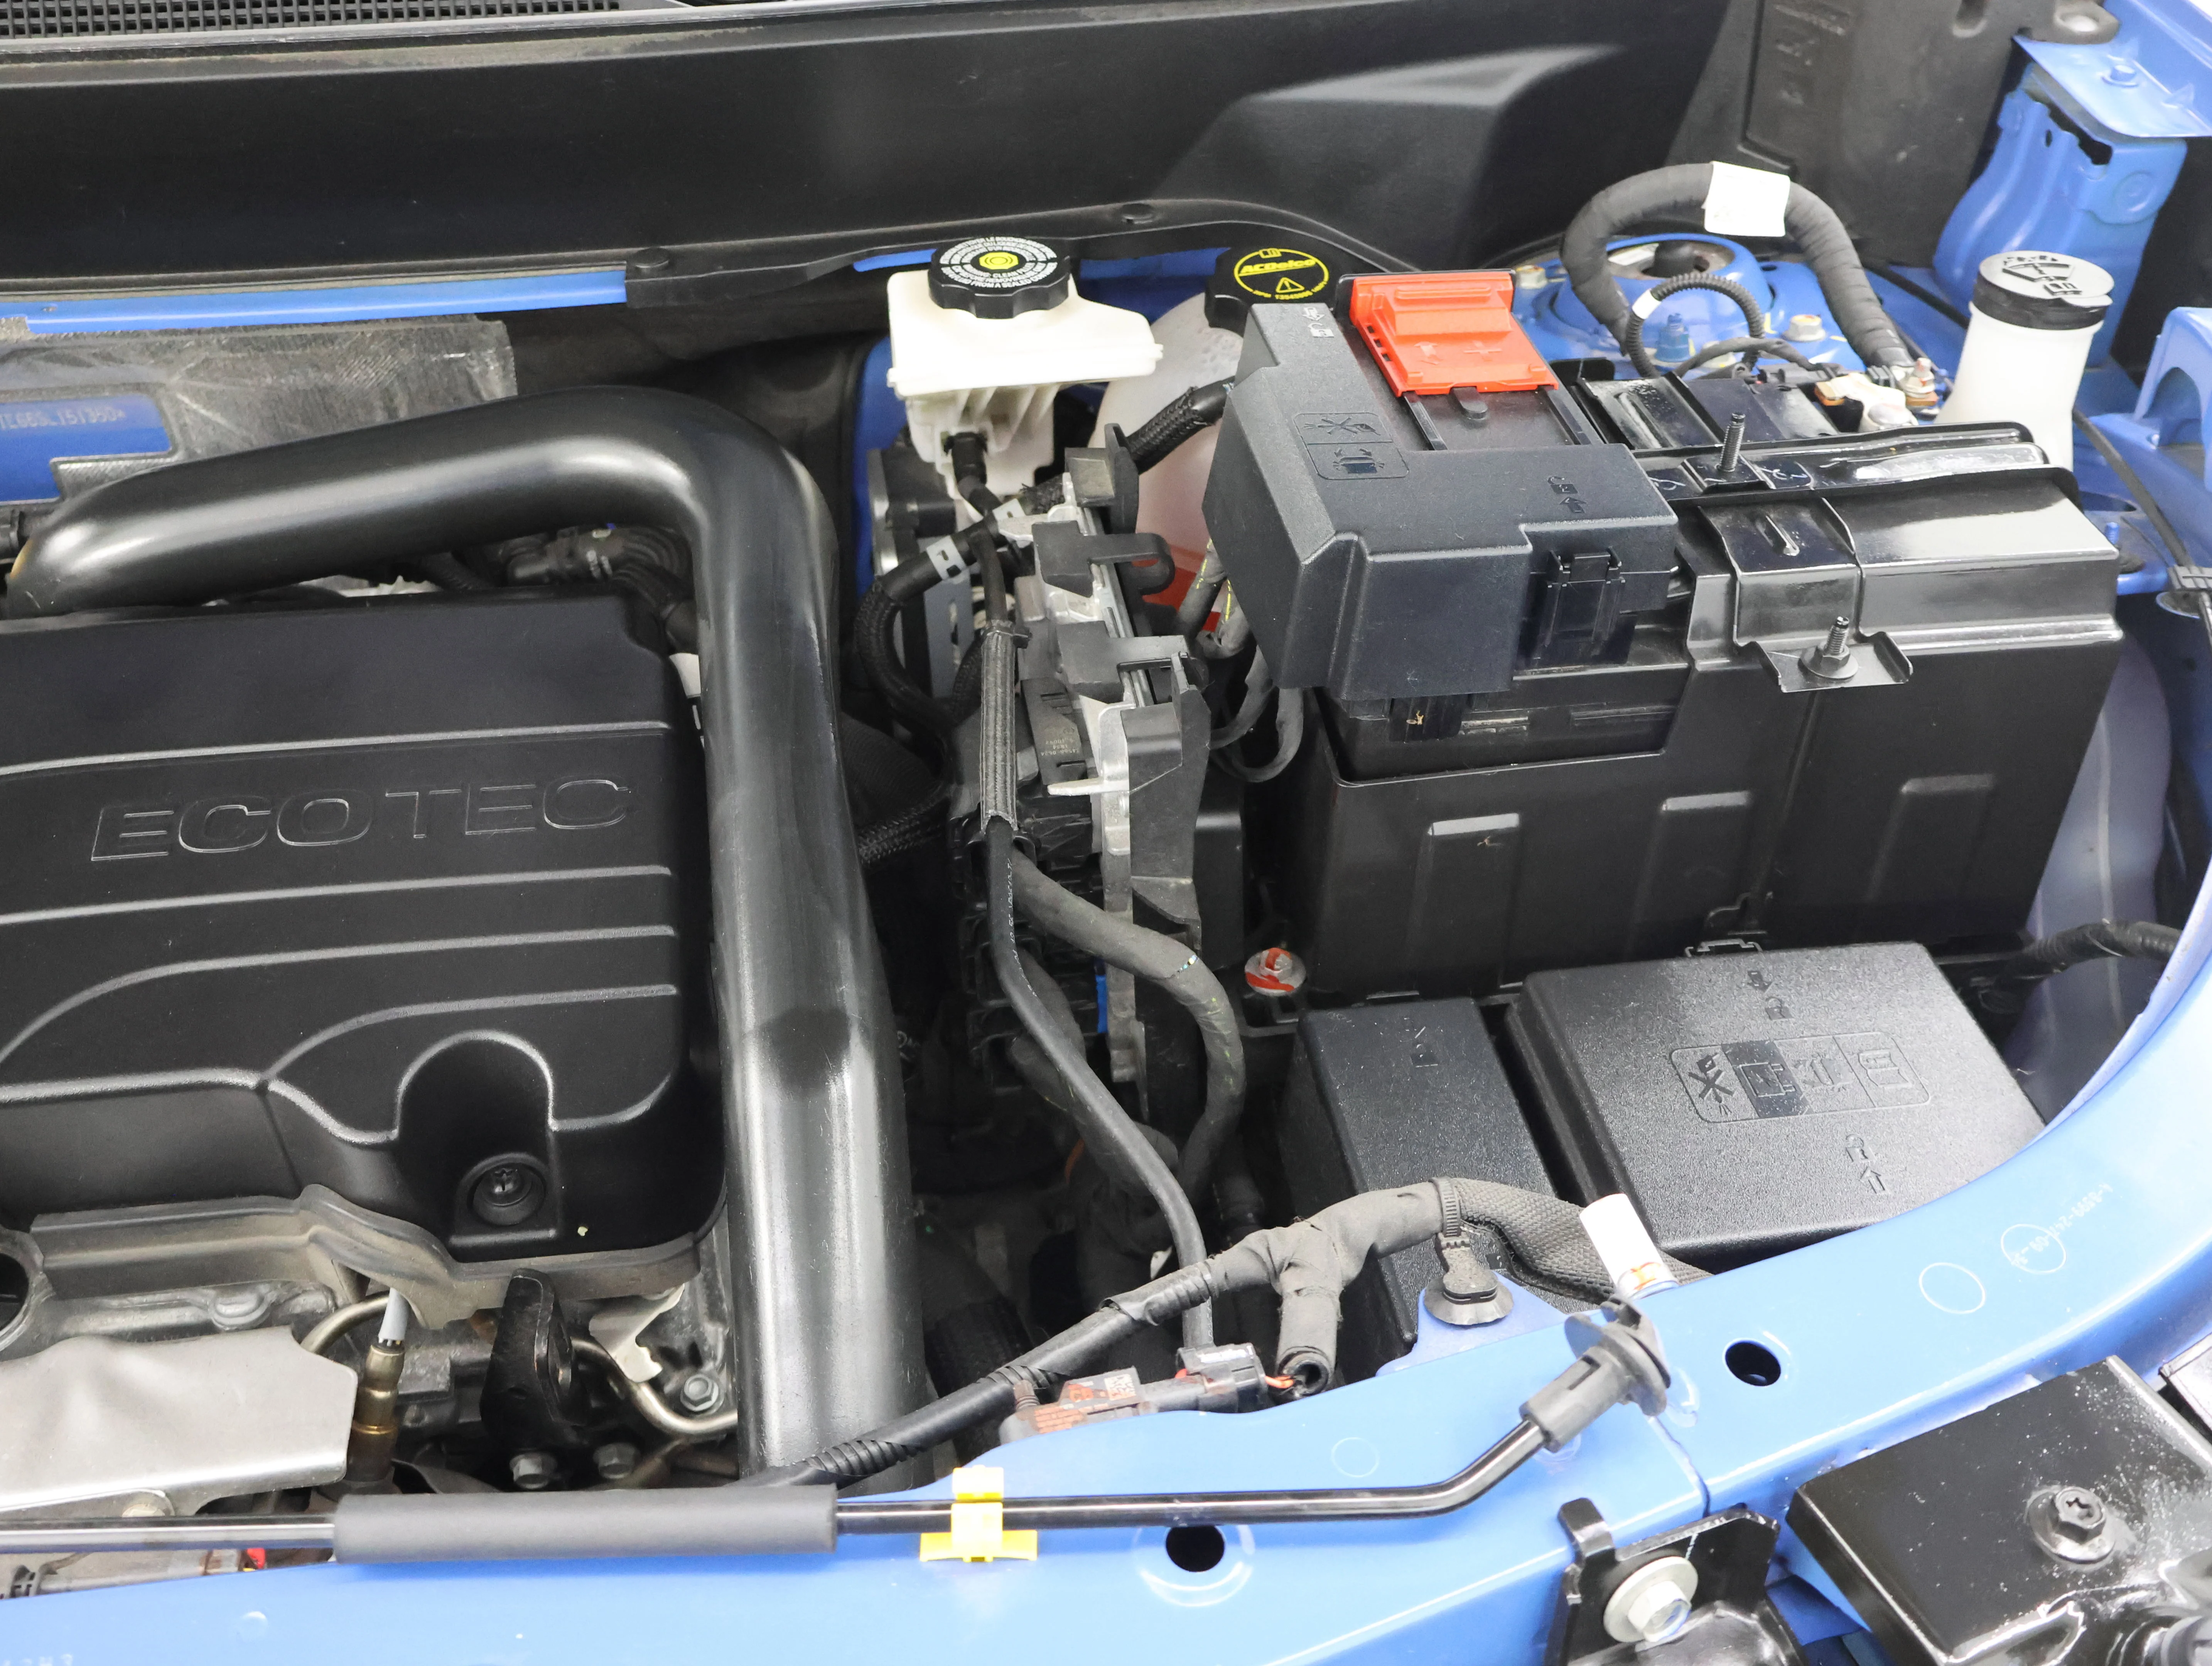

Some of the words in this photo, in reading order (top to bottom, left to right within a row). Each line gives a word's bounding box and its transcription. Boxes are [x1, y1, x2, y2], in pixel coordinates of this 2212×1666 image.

[1240, 259, 1316, 273] ACDelco
[1001, 278, 1032, 288] SEALED
[91, 775, 629, 861] ECOTEC
